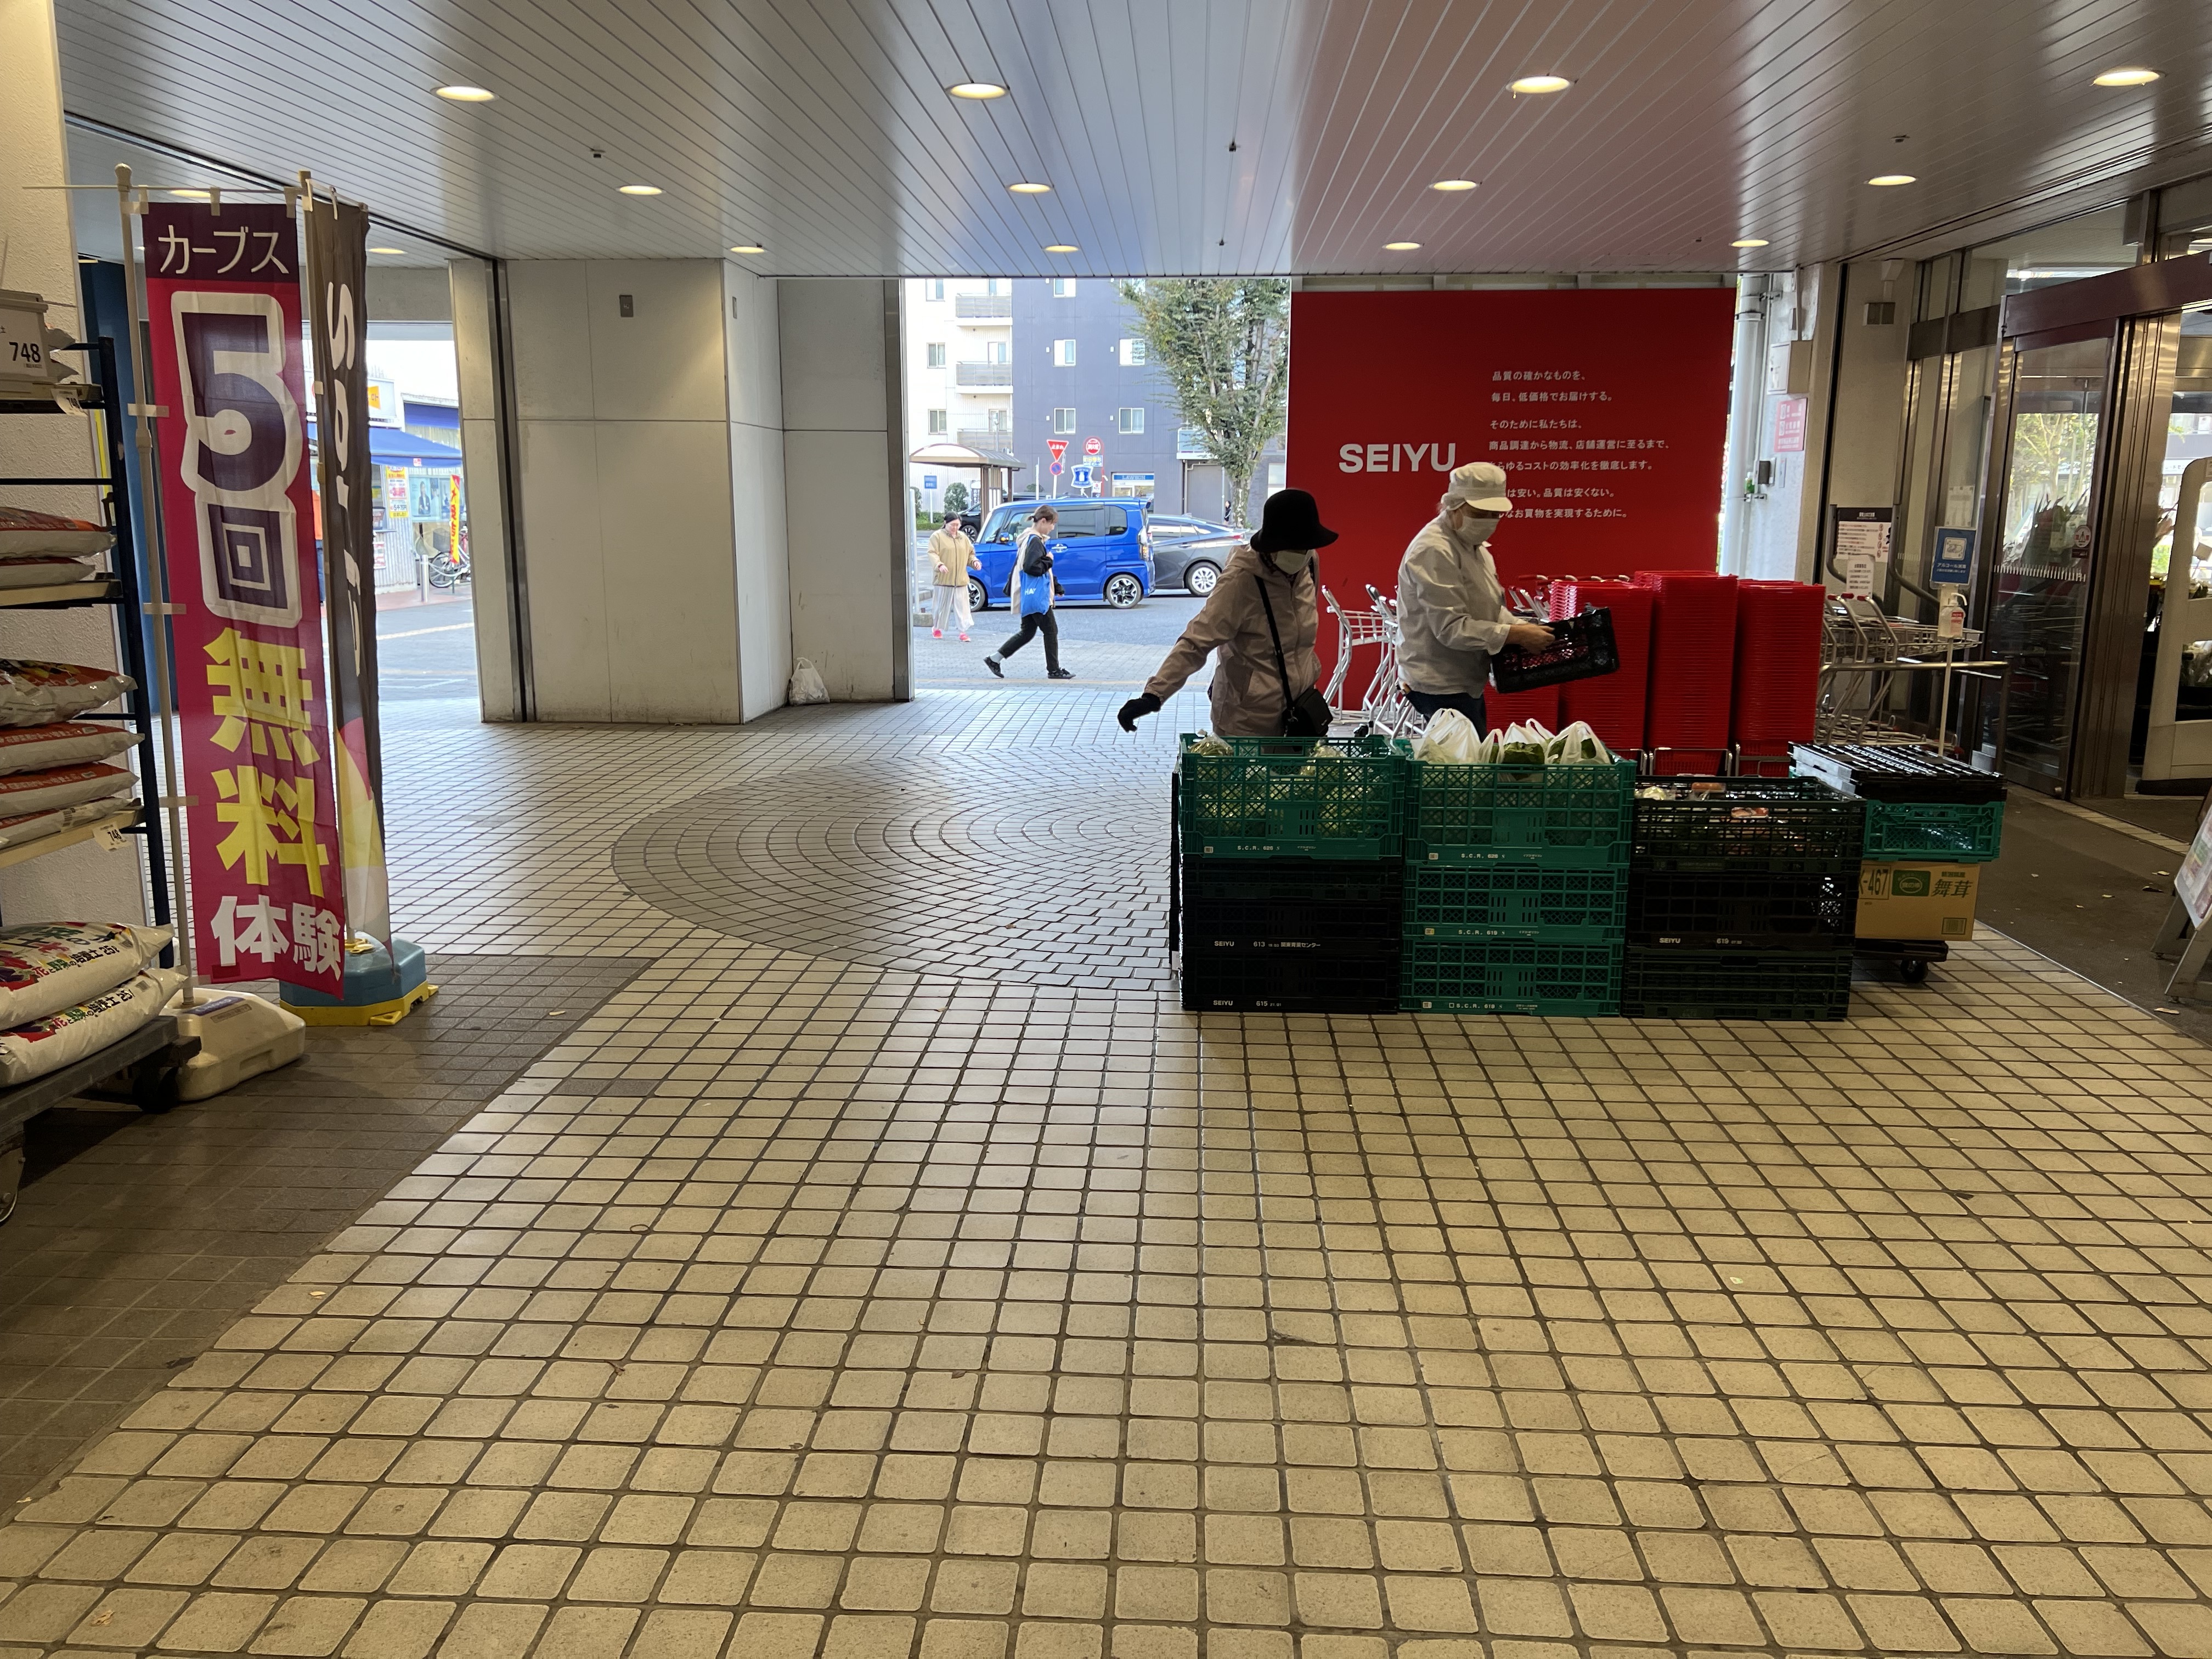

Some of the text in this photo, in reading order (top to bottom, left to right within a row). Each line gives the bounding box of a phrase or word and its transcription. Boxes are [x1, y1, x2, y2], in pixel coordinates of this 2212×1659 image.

[159, 224, 289, 274] カーブス
[9, 341, 41, 363] 748
[1492, 370, 1585, 381] 品質の確かなものを、
[1491, 391, 1612, 402] 毎日、低価格でお届けする。
[1489, 419, 1582, 430] そのために私たちは、
[1339, 443, 1457, 473] SEIYU
[1488, 460, 1652, 471] らゆるコストの効率化を徹底します。
[1024, 588, 1037, 596] HAY
[1931, 879, 1973, 898] 舞茸
[211, 895, 341, 982] 体験
